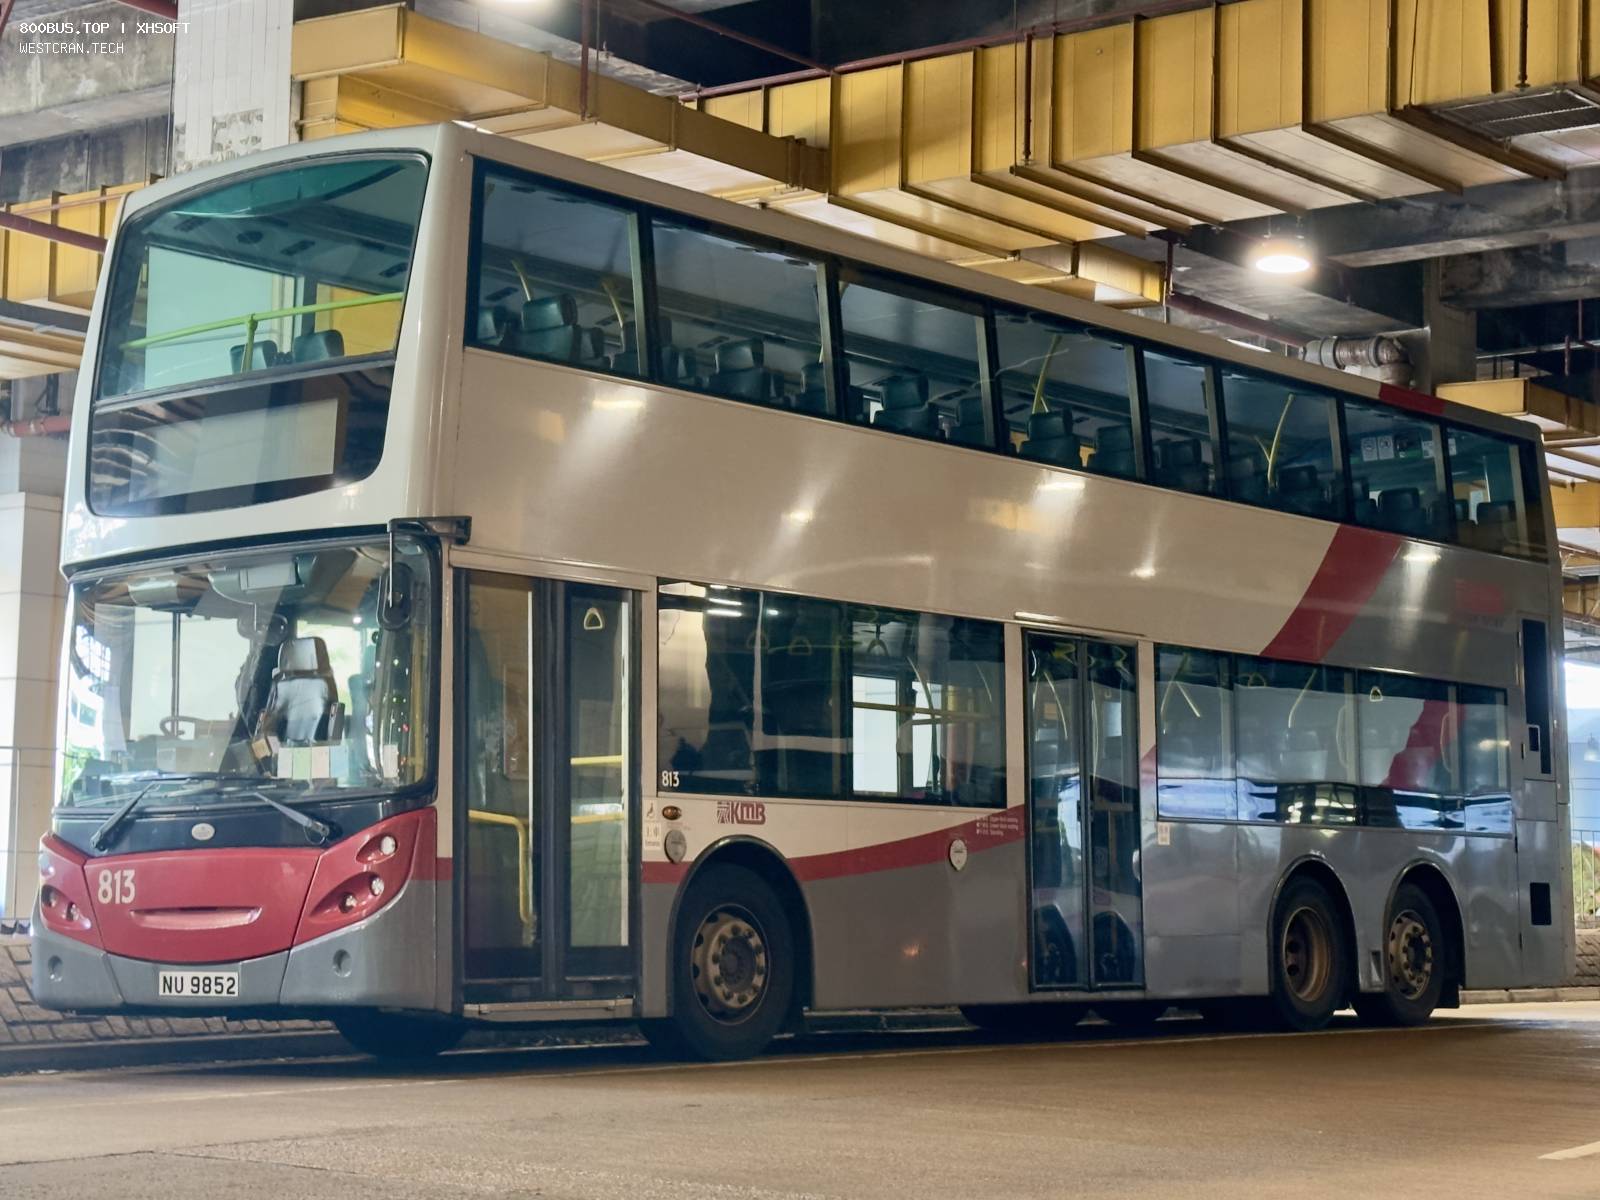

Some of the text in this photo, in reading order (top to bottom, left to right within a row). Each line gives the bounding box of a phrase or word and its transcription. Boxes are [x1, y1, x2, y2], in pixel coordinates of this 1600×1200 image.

[661, 770, 680, 788] 813
[730, 800, 766, 825] KMB
[97, 869, 136, 904] 813
[162, 976, 236, 995] NU 9852
